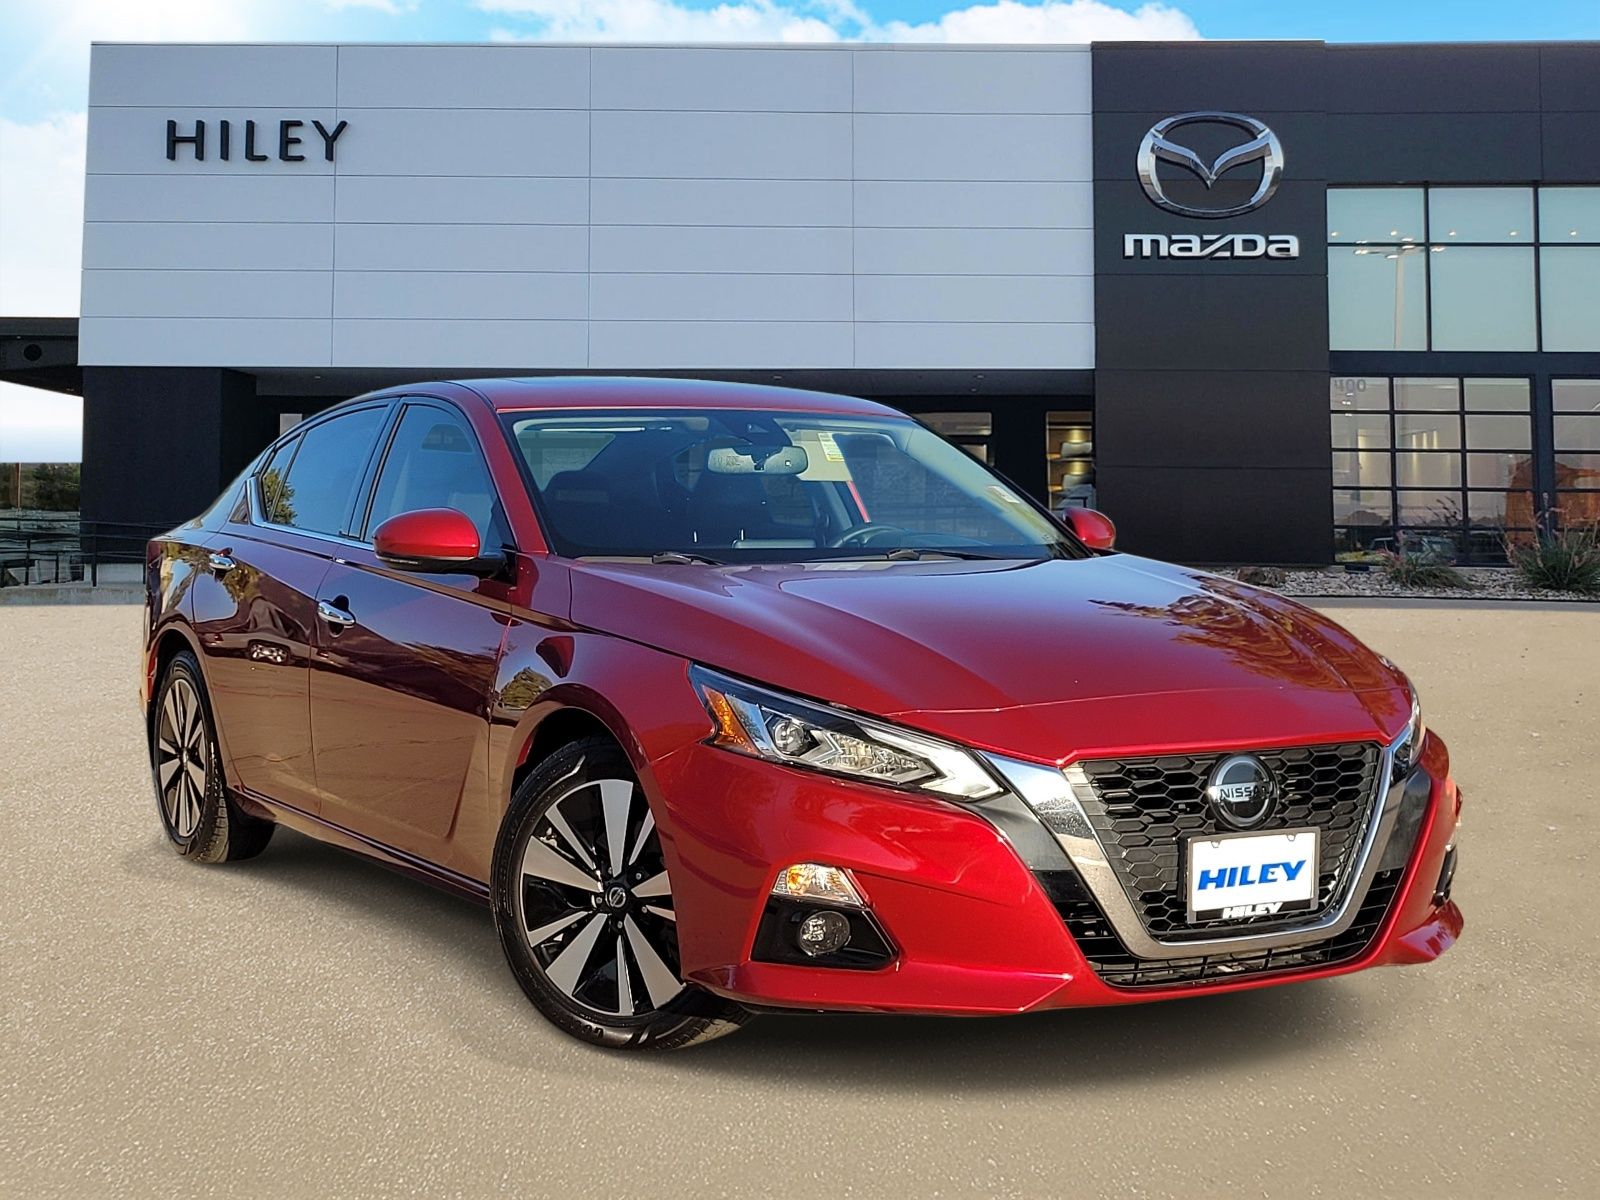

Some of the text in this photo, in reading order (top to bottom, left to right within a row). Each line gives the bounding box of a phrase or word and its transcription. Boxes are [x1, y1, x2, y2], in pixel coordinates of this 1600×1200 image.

[166, 120, 348, 161] HILEY
[1197, 860, 1307, 890] HILEY
[1222, 902, 1284, 919] HILEY
